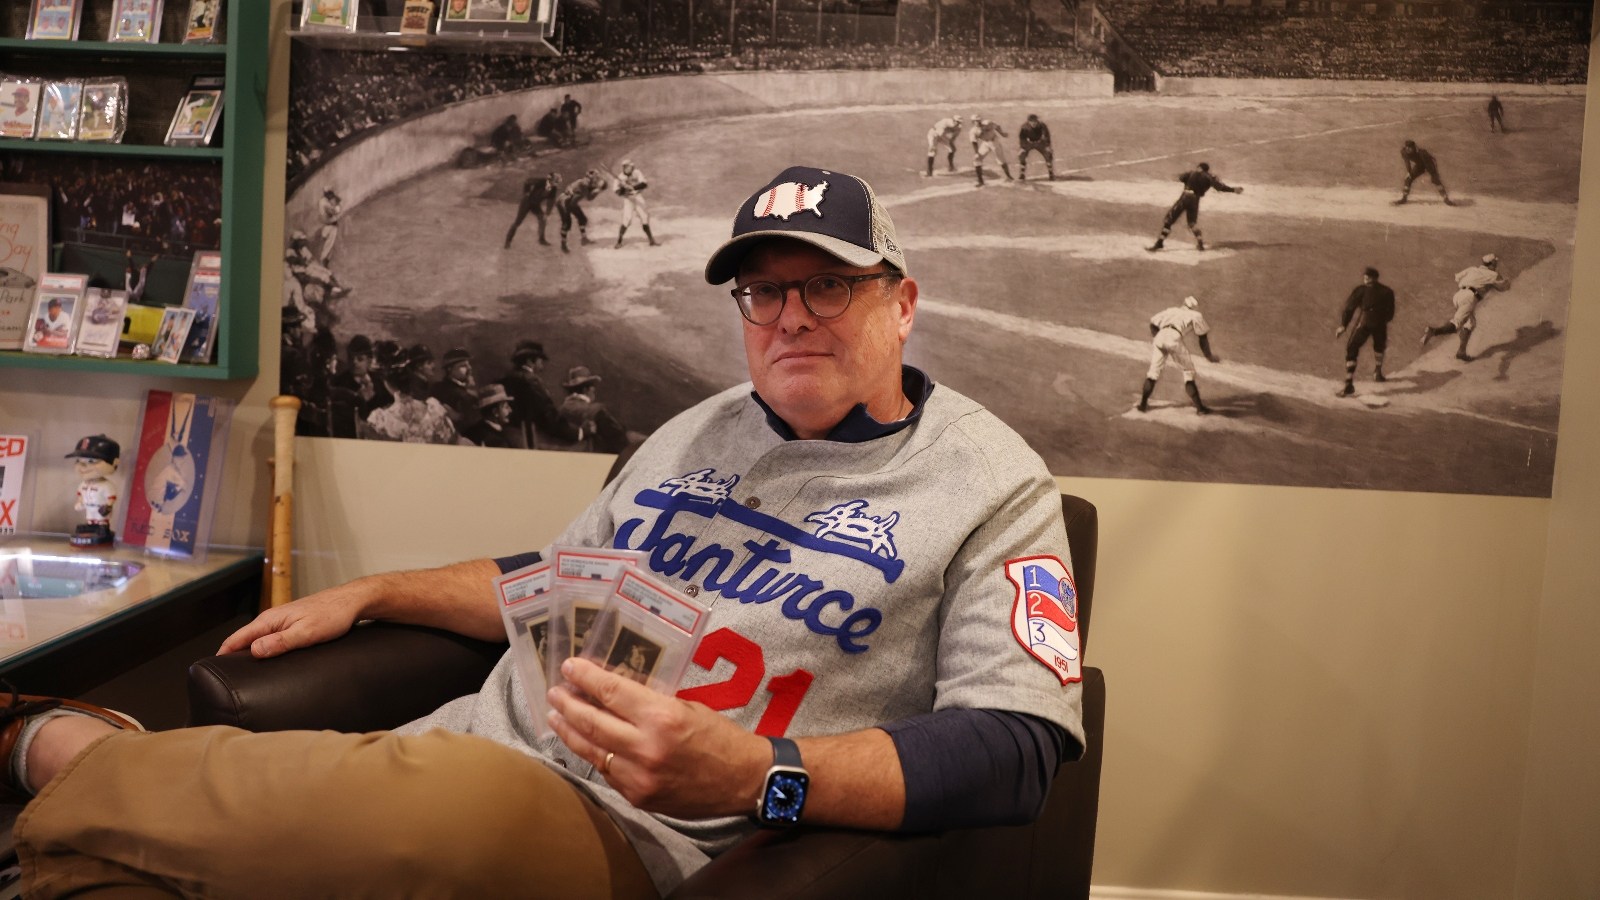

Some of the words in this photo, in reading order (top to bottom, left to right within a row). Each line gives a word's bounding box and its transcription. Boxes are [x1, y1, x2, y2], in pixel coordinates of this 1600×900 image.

[163, 528, 190, 543] SOX
[1029, 566, 1042, 587] 1
[1030, 592, 1043, 615] 2
[1032, 621, 1046, 643] 3
[1053, 655, 1069, 673] 1951
[676, 626, 815, 738] 21
